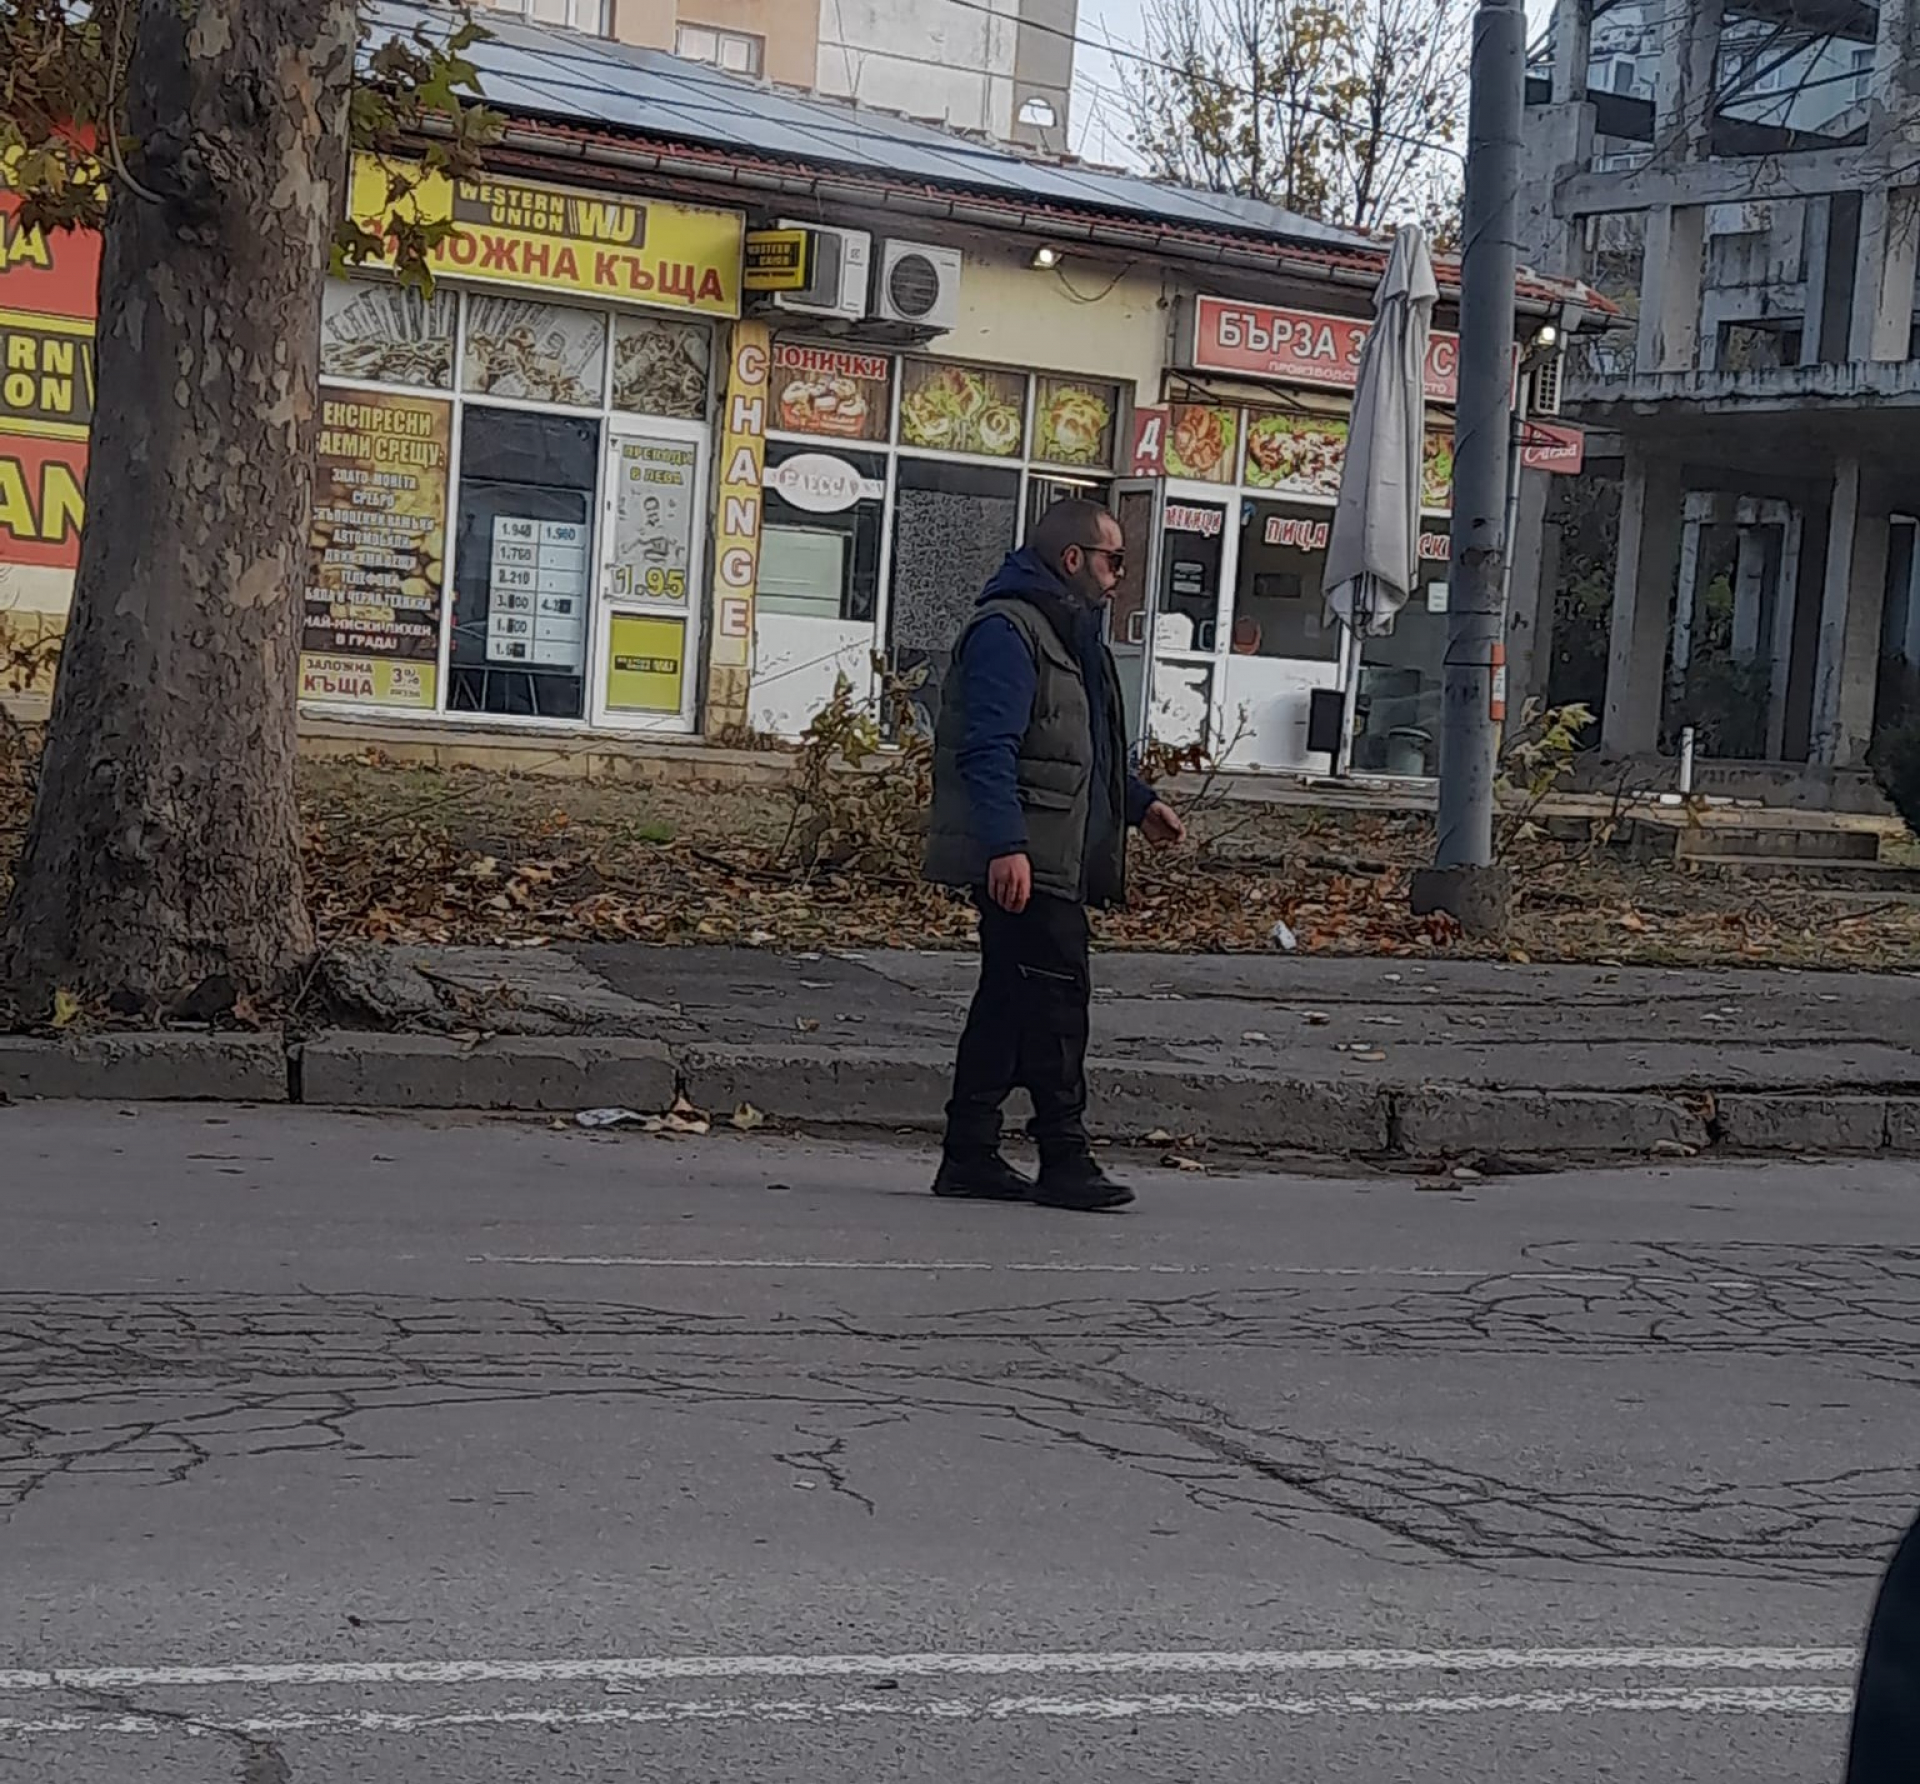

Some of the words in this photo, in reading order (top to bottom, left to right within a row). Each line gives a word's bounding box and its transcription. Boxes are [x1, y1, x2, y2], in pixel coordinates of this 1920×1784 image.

[459, 180, 565, 214] WESTERN
[491, 205, 563, 233] UNION
[0, 212, 49, 269] А
[361, 219, 580, 283] ОЖНА
[594, 251, 724, 304] КЪЩА
[1218, 310, 1337, 361] БЪРЗА
[0, 334, 74, 375] RN
[323, 401, 432, 436] ЕКСПРЕСНИ
[316, 431, 372, 460] АЕМИ
[720, 344, 766, 636] CHANGE
[1265, 517, 1330, 552] ПИЦА
[1418, 532, 1451, 560] СК
[304, 674, 374, 698] КЪЩА
